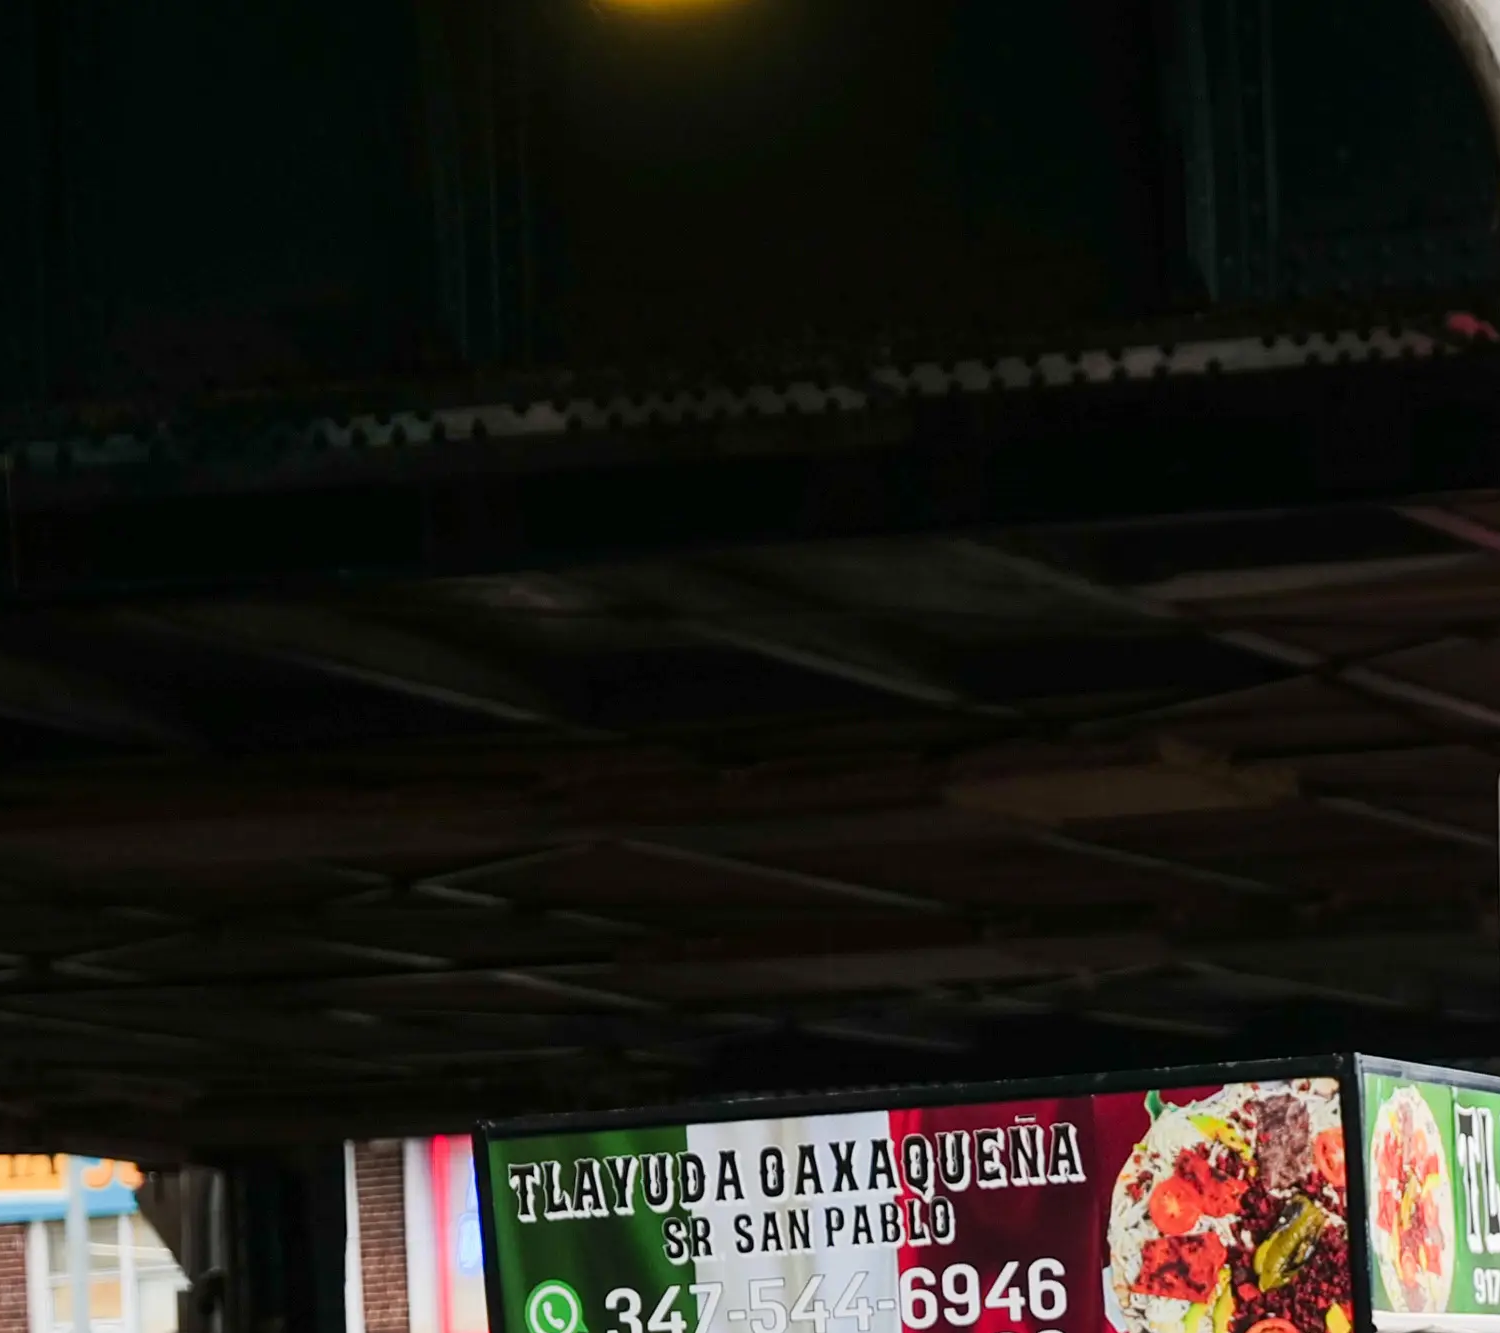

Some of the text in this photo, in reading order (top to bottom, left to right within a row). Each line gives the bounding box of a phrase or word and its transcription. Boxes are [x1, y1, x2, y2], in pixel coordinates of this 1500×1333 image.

[508, 1114, 1087, 1223] TLAYUDA OAXAQUEÑA
[734, 1207, 813, 1255] SAN
[825, 1195, 956, 1249] PABLO
